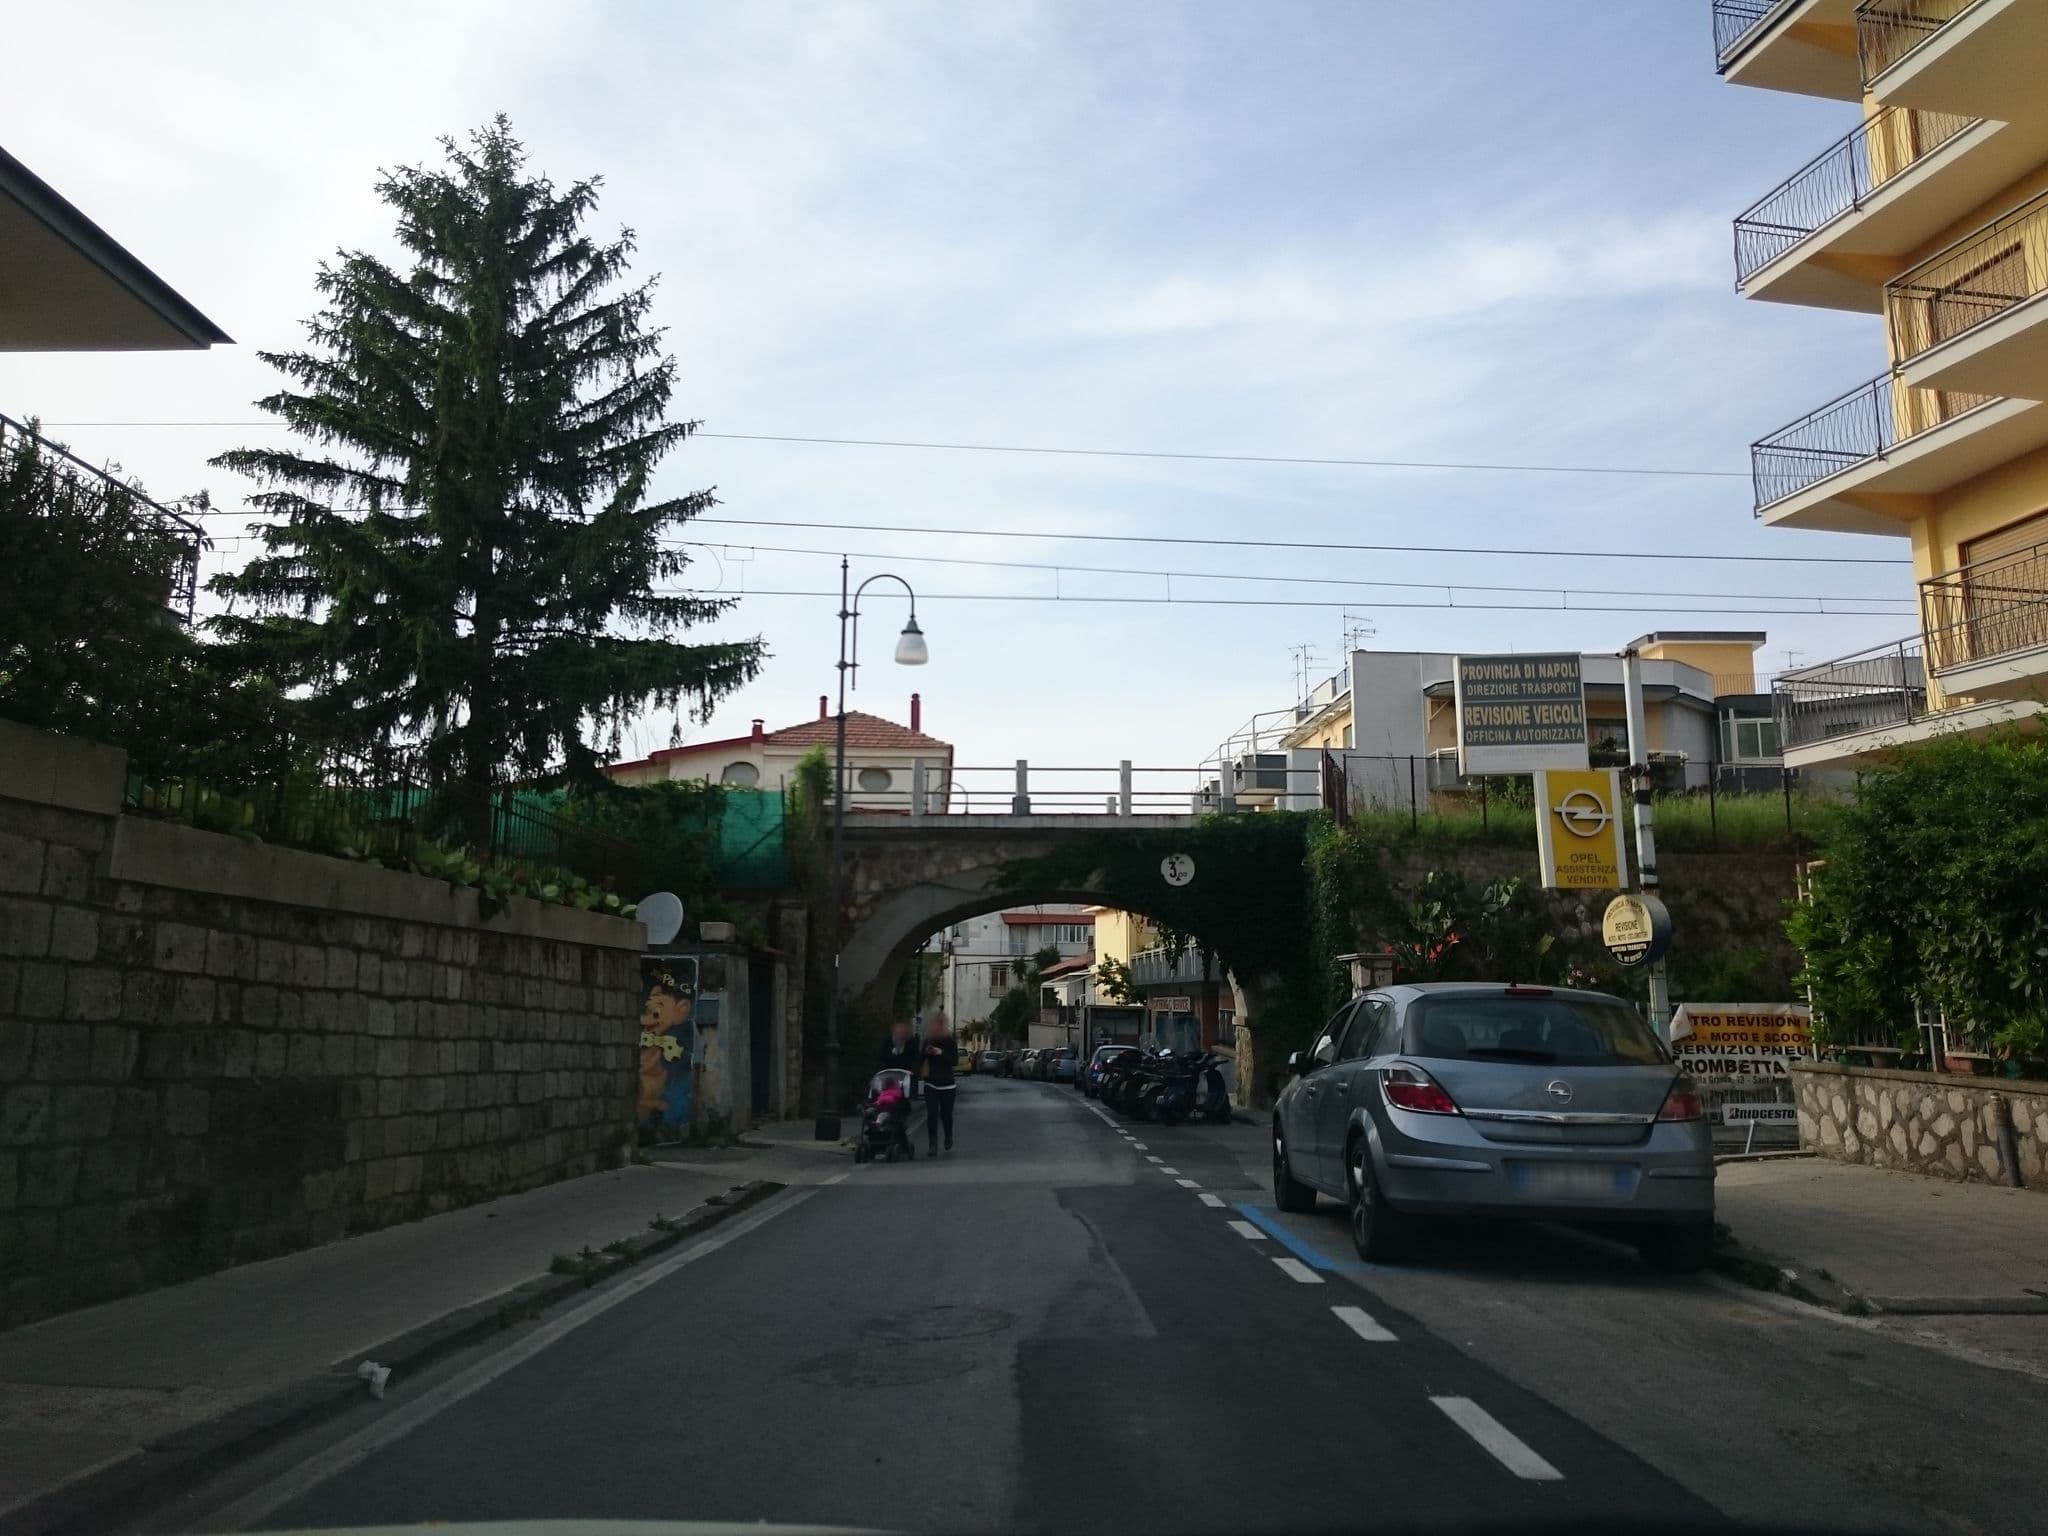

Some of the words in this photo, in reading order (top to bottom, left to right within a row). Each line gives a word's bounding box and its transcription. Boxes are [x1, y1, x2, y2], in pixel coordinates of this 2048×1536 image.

[1462, 664, 1521, 680] PROVINCIA
[1524, 663, 1536, 679] DI
[1539, 662, 1579, 679] NAPOLI
[1467, 683, 1519, 695] DIREZIONE
[1522, 681, 1576, 694] TRASPORTI
[1464, 705, 1531, 726] REVISIONE
[1533, 704, 1582, 724] VEICOLI
[1466, 729, 1511, 743] OFFICINA
[1515, 728, 1583, 741] AUTORIZZATA
[1570, 853, 1601, 864] OPEL
[1556, 864, 1617, 874] ASSISTENZA
[1567, 875, 1609, 885] VENDITA
[1689, 1016, 1721, 1027] TRO
[1726, 1016, 1800, 1028] REVISIONI
[1711, 1032, 1748, 1042] MOTO
[1752, 1033, 1759, 1042] E
[1765, 1033, 1811, 1043] SCOOT
[1672, 1045, 1755, 1055] SERVIZIO
[1728, 1107, 1795, 1119] BRIDGESTO
